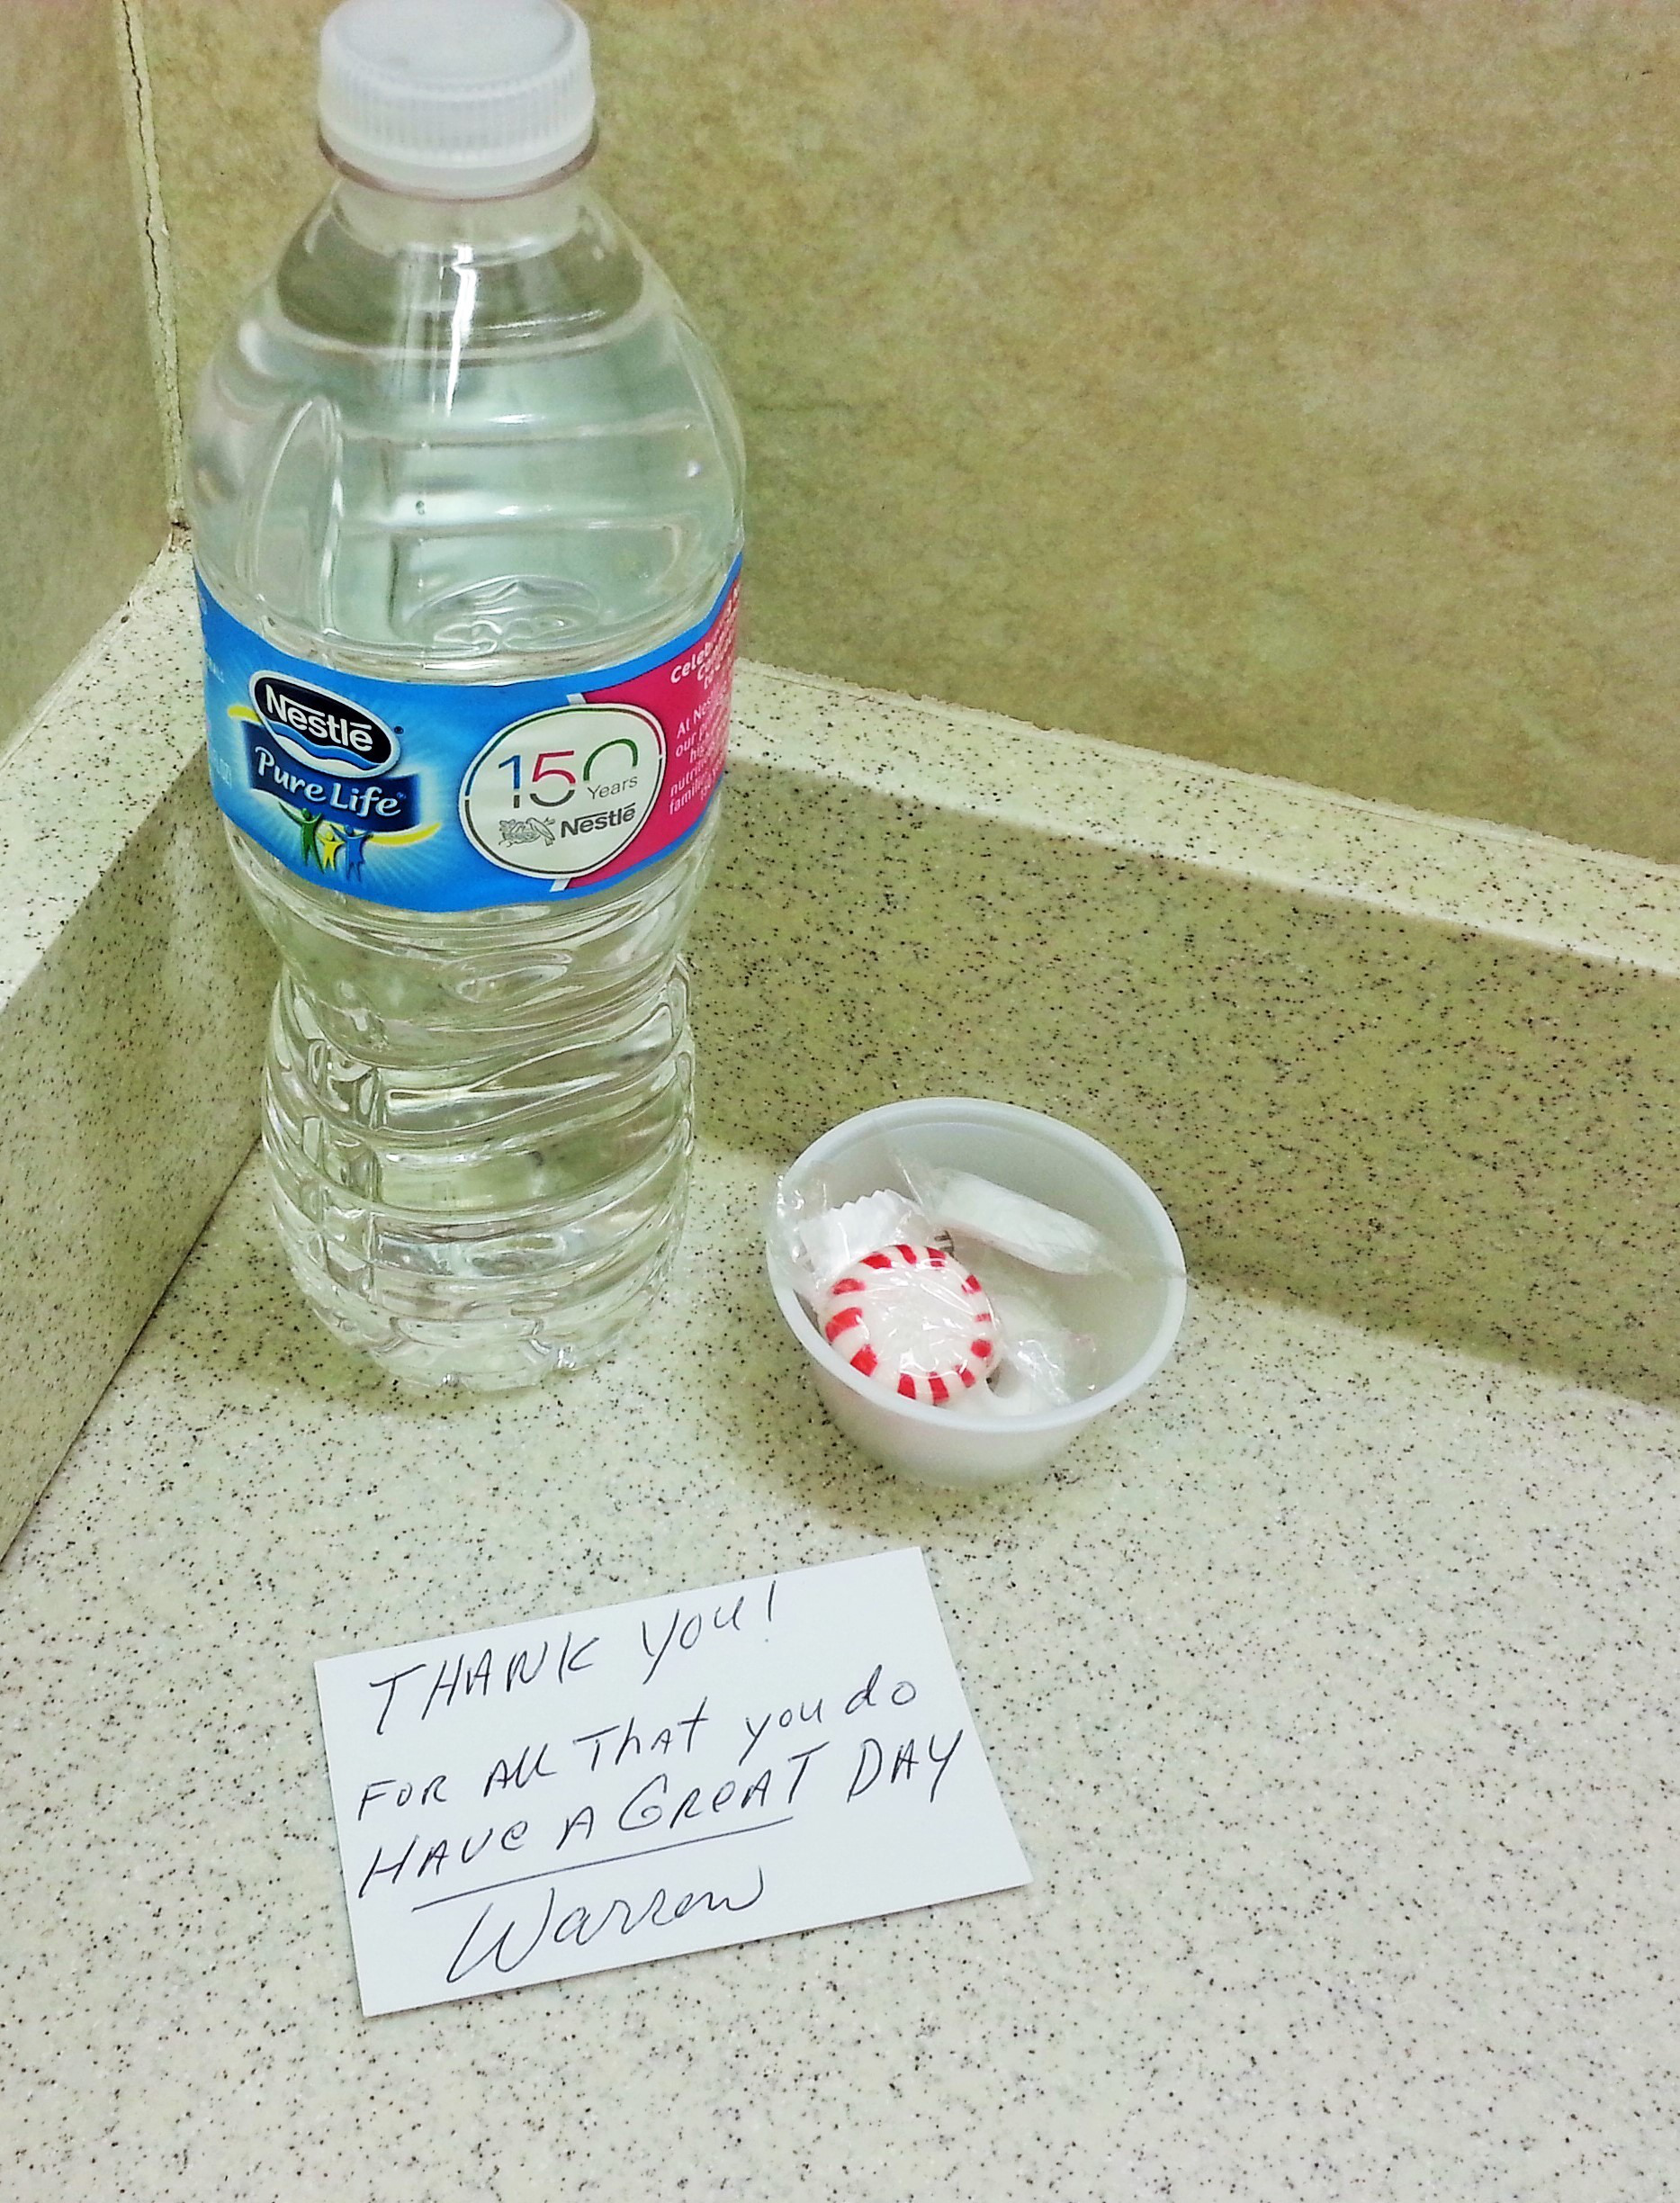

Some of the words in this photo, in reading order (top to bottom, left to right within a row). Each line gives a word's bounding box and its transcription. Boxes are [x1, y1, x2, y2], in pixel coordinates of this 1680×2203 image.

[255, 746, 326, 802] Pure
[330, 782, 401, 817] Life
[498, 738, 638, 809] 150
[587, 776, 638, 800] Years
[675, 732, 697, 758] our
[370, 1632, 599, 1735] THANK
[358, 1775, 447, 1821] FOR
[739, 1698, 822, 1766] you
[845, 1664, 916, 1714] do
[556, 1805, 595, 1850] A
[847, 1730, 963, 1803] DAY
[446, 1865, 764, 1983] Warren
